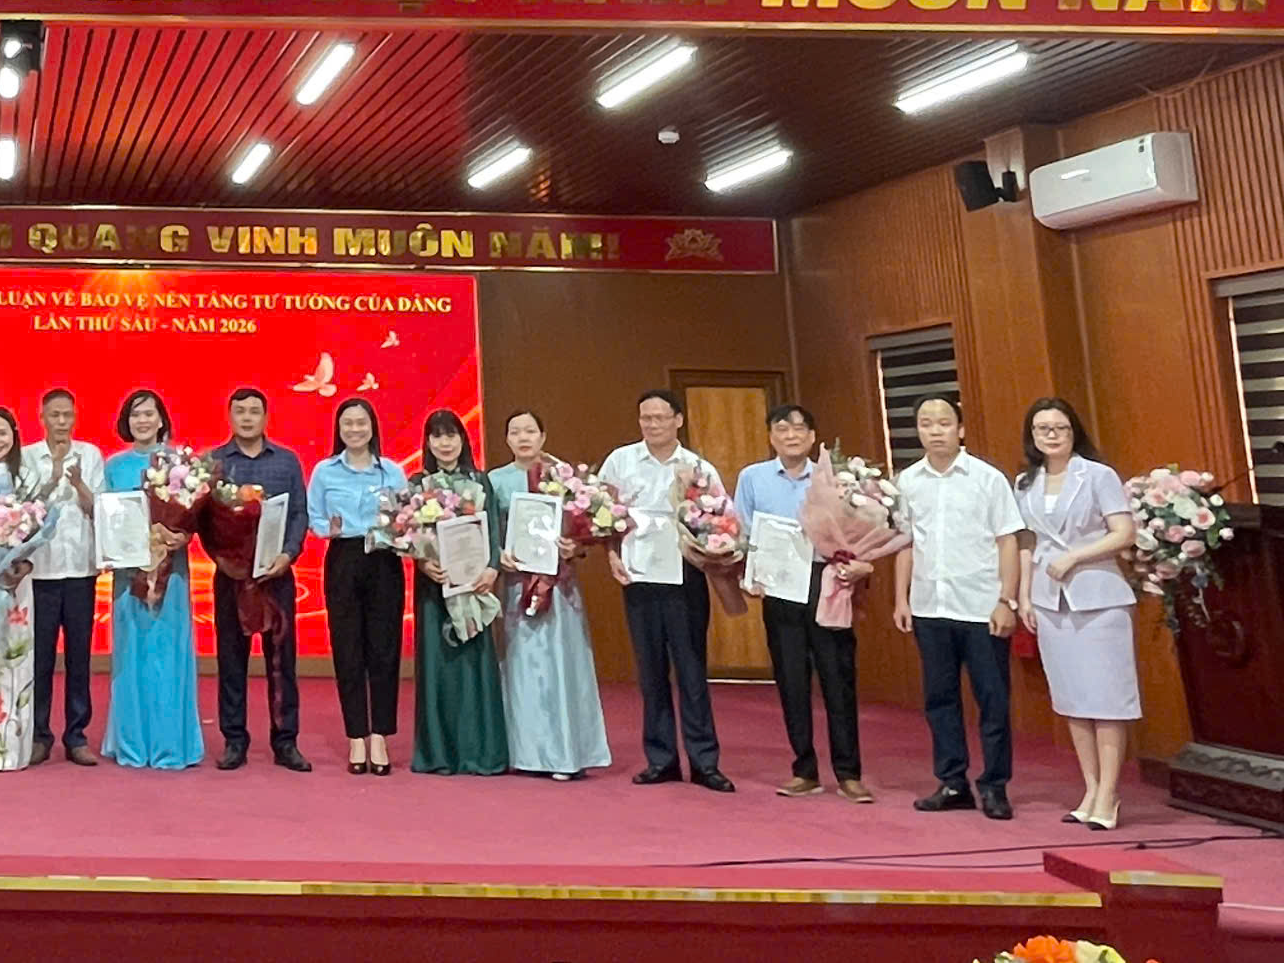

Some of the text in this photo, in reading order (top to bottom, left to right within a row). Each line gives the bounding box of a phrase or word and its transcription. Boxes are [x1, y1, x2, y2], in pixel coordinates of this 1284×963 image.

[28, 223, 190, 254] QUANG
[207, 225, 318, 254] VINH
[333, 223, 474, 258] MUÔN
[252, 292, 280, 310] TƯ
[172, 314, 215, 333] NĂM
[219, 317, 257, 333] 2026
